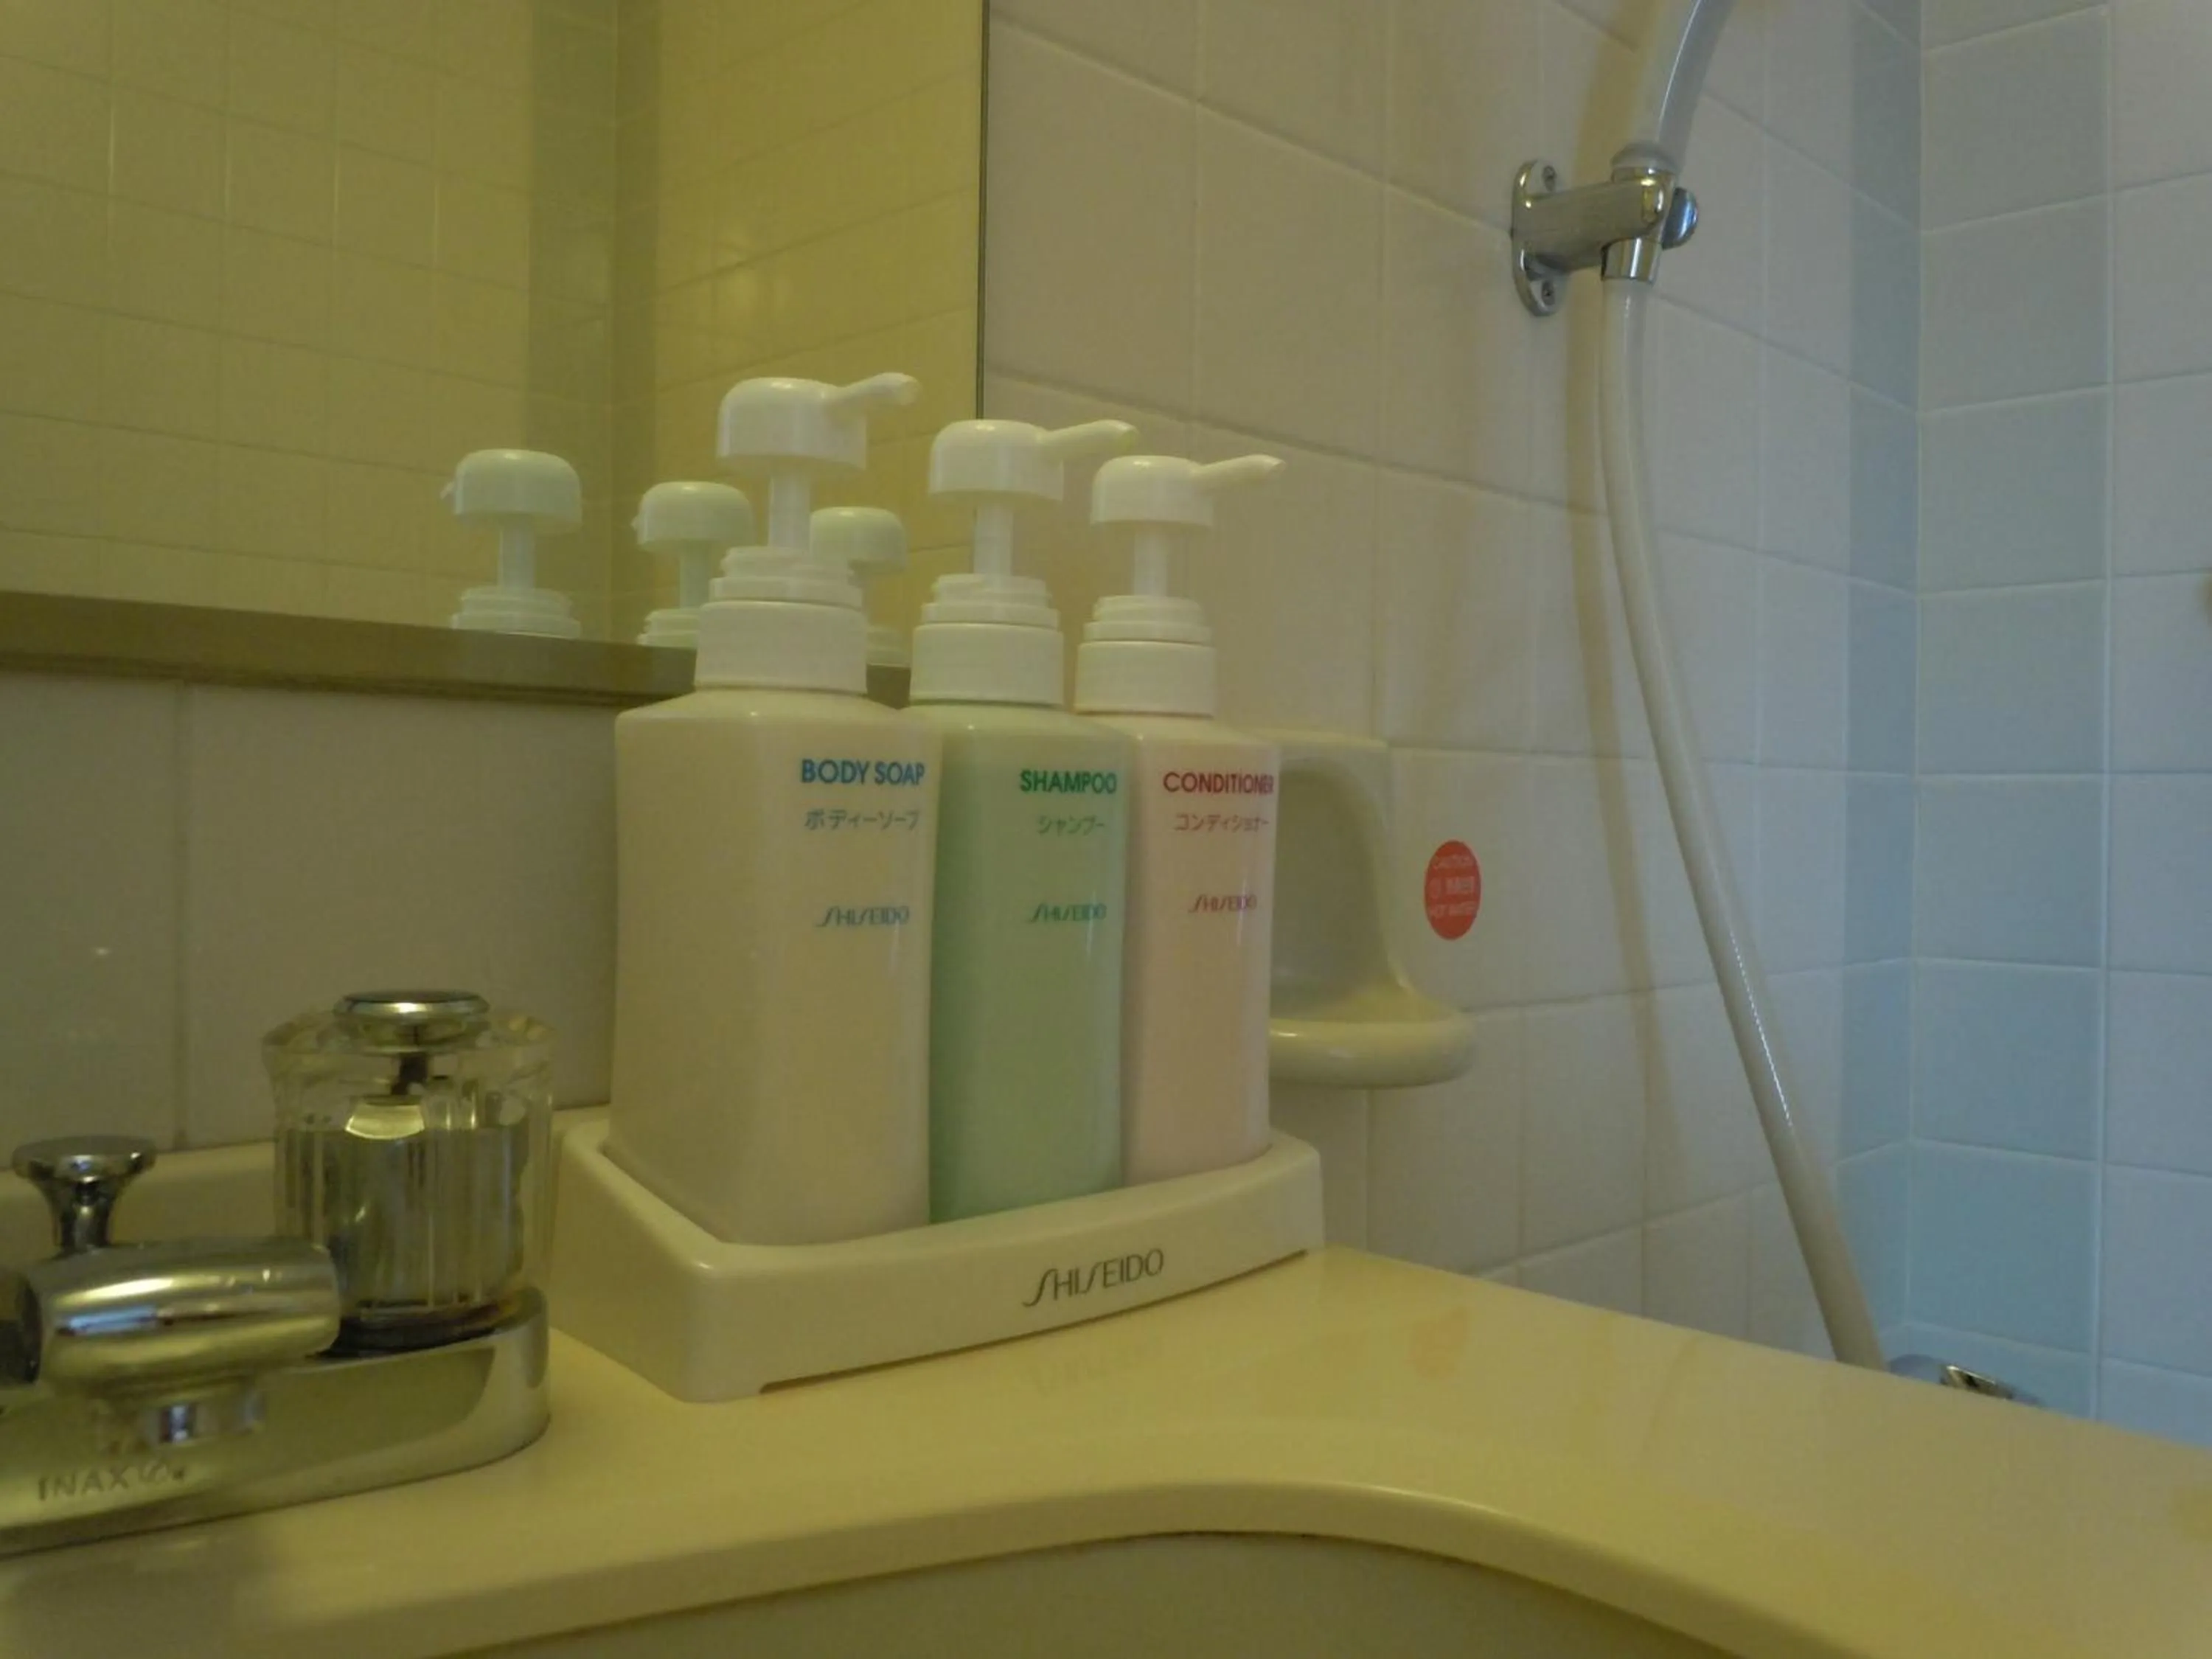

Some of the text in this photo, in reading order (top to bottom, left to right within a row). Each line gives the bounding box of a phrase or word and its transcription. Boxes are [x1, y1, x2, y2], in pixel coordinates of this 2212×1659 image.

[801, 759, 925, 786] BODY SOAP
[1020, 770, 1118, 794] SHAMPOO
[1164, 771, 1274, 794] CONDITIONER
[815, 905, 910, 928] SHISEIDO
[1022, 1248, 1164, 1308] SHISEIDO
